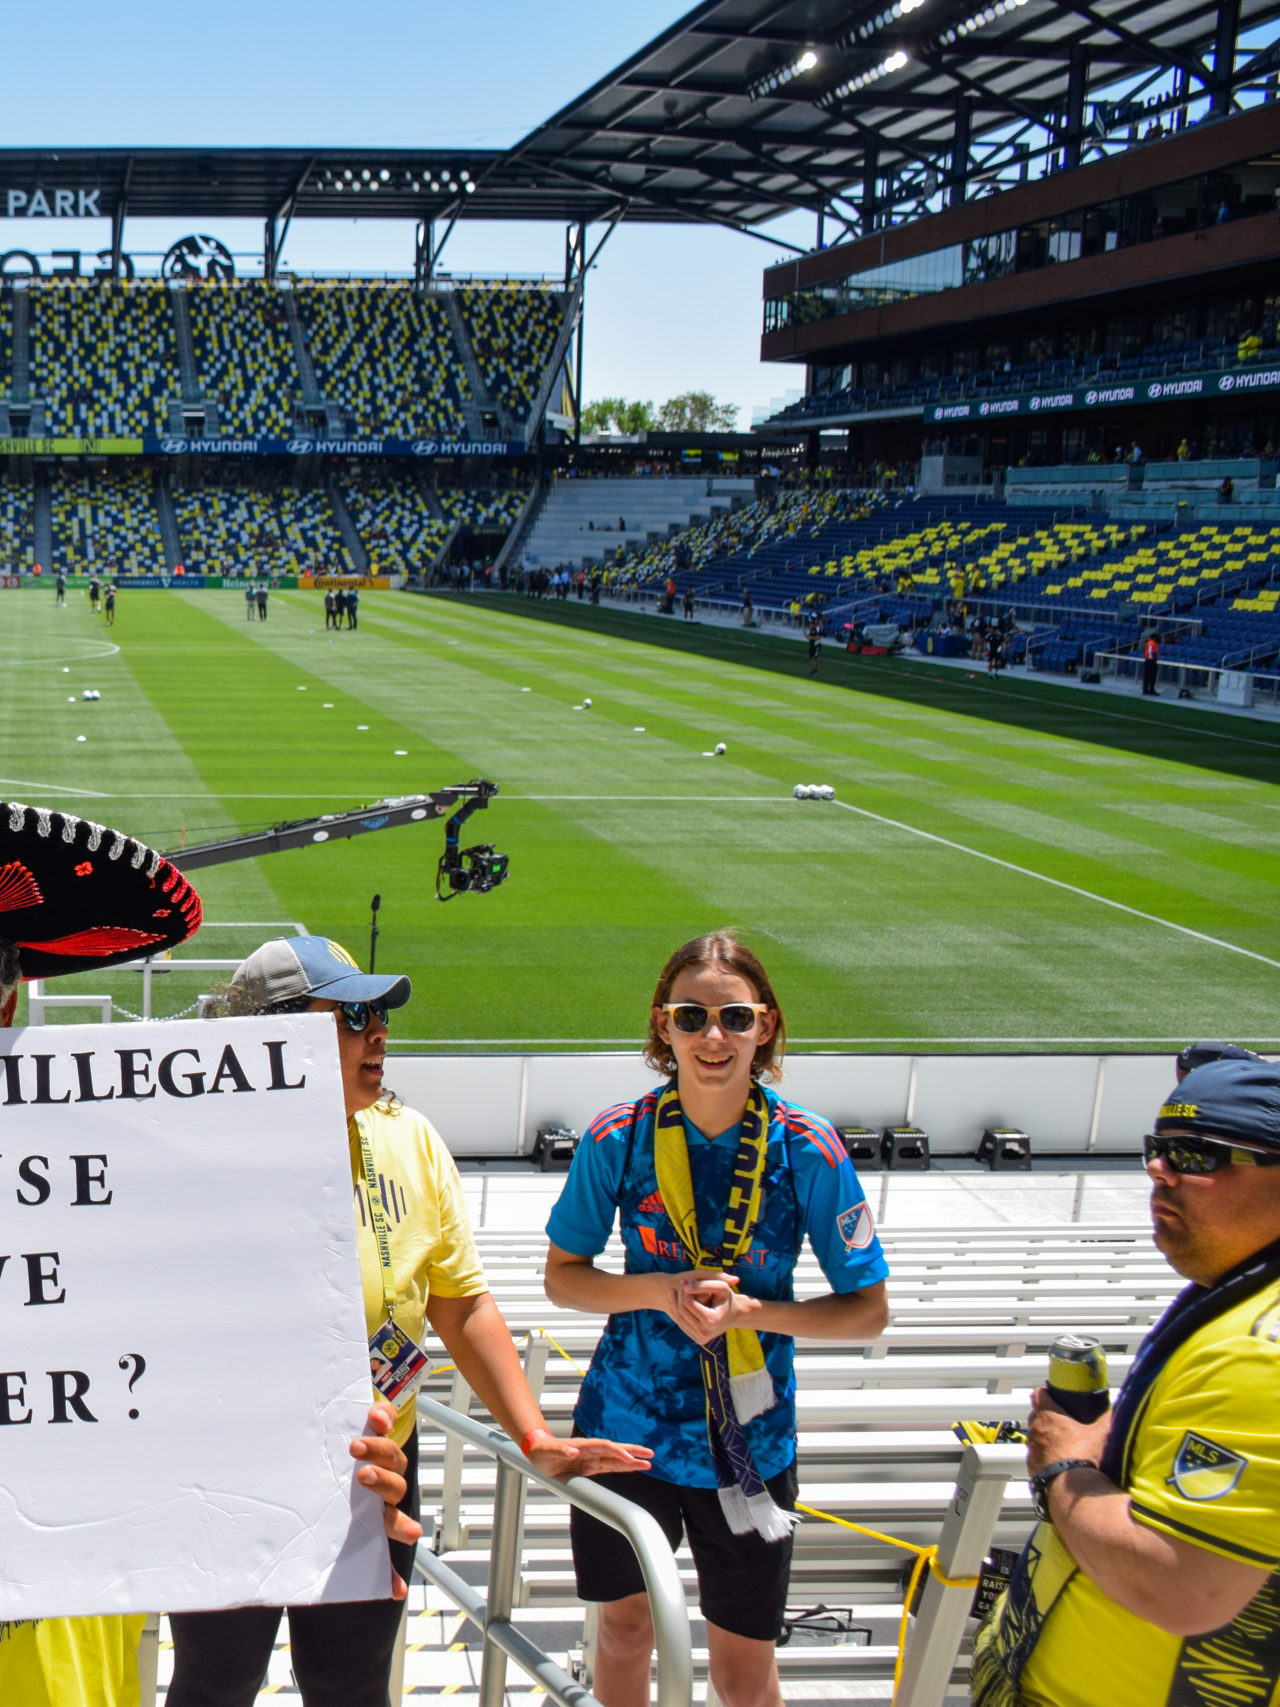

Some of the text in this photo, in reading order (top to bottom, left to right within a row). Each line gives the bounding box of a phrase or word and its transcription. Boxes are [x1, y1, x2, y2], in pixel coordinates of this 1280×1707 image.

[7, 189, 101, 218] PARK
[1099, 387, 1135, 403] HYUNDAI
[1163, 379, 1203, 396] HYUNDAI
[990, 400, 1019, 413] HYUNDAI
[1041, 394, 1073, 409] HYUNDAI
[944, 405, 970, 418] HYUNDAI
[191, 440, 258, 452] HYUNDAI
[316, 441, 383, 454] HYUNDAI
[441, 442, 507, 455] HYUNDAI
[363, 1149, 378, 1189] NASHVILLE
[374, 1213, 392, 1268] NASHVILLE SC
[1187, 1439, 1220, 1464] MLS
